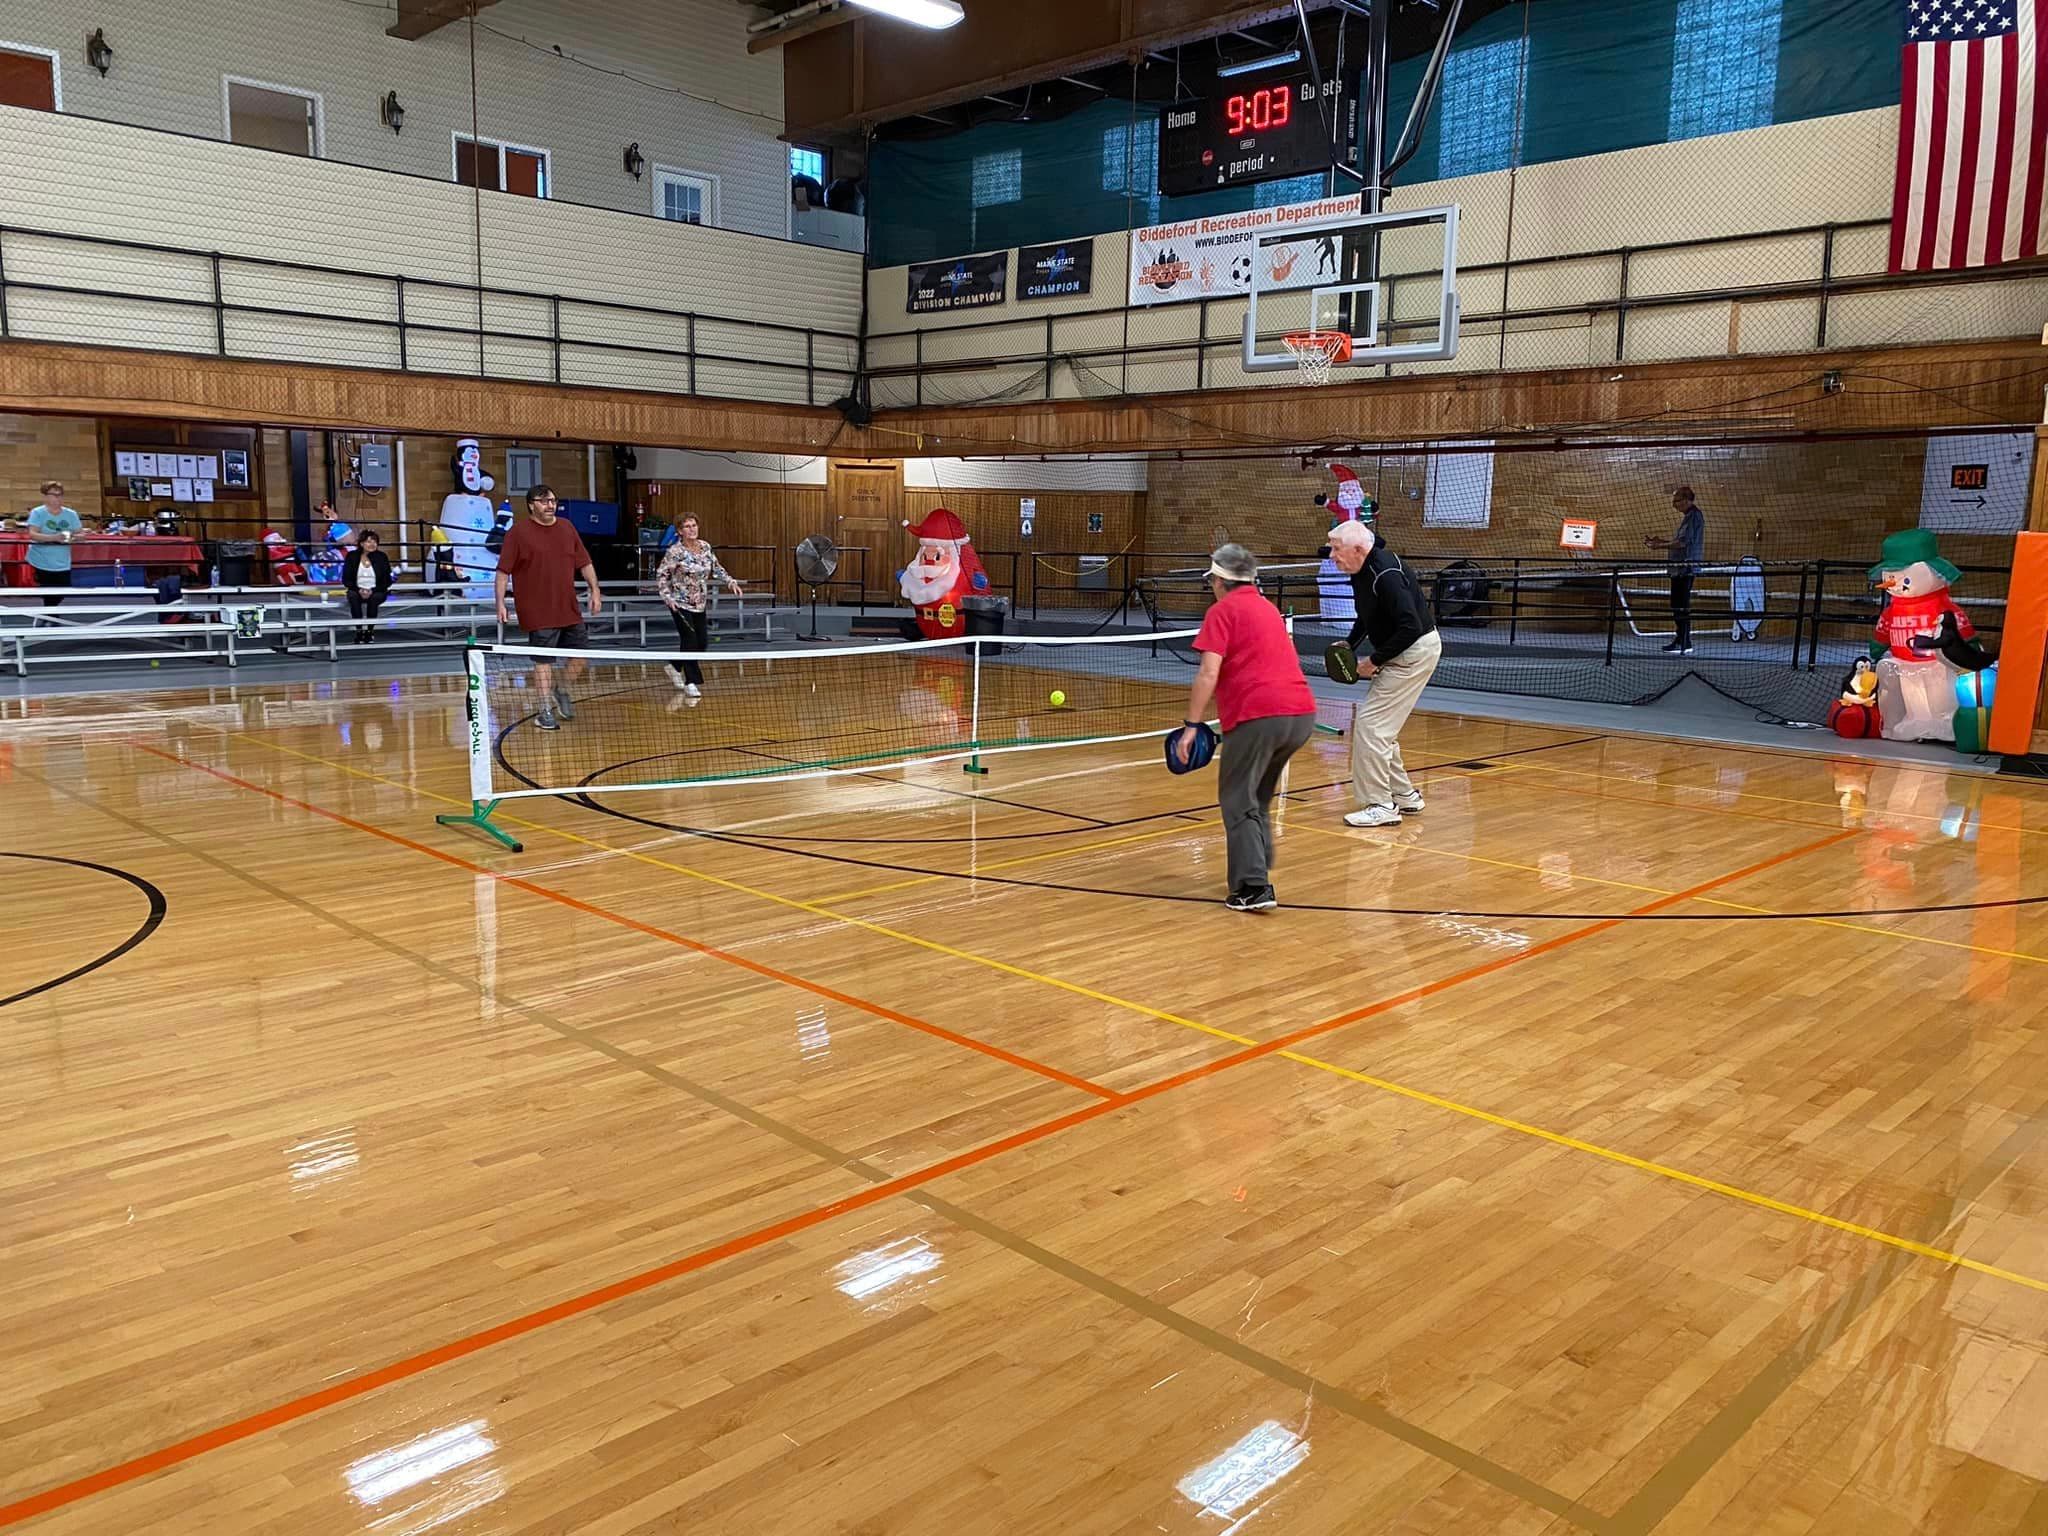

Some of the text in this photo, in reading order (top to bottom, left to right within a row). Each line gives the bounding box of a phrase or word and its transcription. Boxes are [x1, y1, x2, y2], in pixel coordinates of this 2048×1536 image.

[1300, 80, 1343, 101] Gusts
[1228, 85, 1290, 134] 9:03
[1167, 111, 1196, 129] Home
[1229, 153, 1264, 178] period
[1139, 196, 1360, 242] Biddeford Recreation Department
[918, 289, 935, 299] 2022
[1027, 281, 1080, 296] CHAMPION
[913, 291, 1002, 310] DIVISION CHAMPION
[1954, 469, 1985, 485] EXIT
[1890, 615, 1929, 628] JUST
